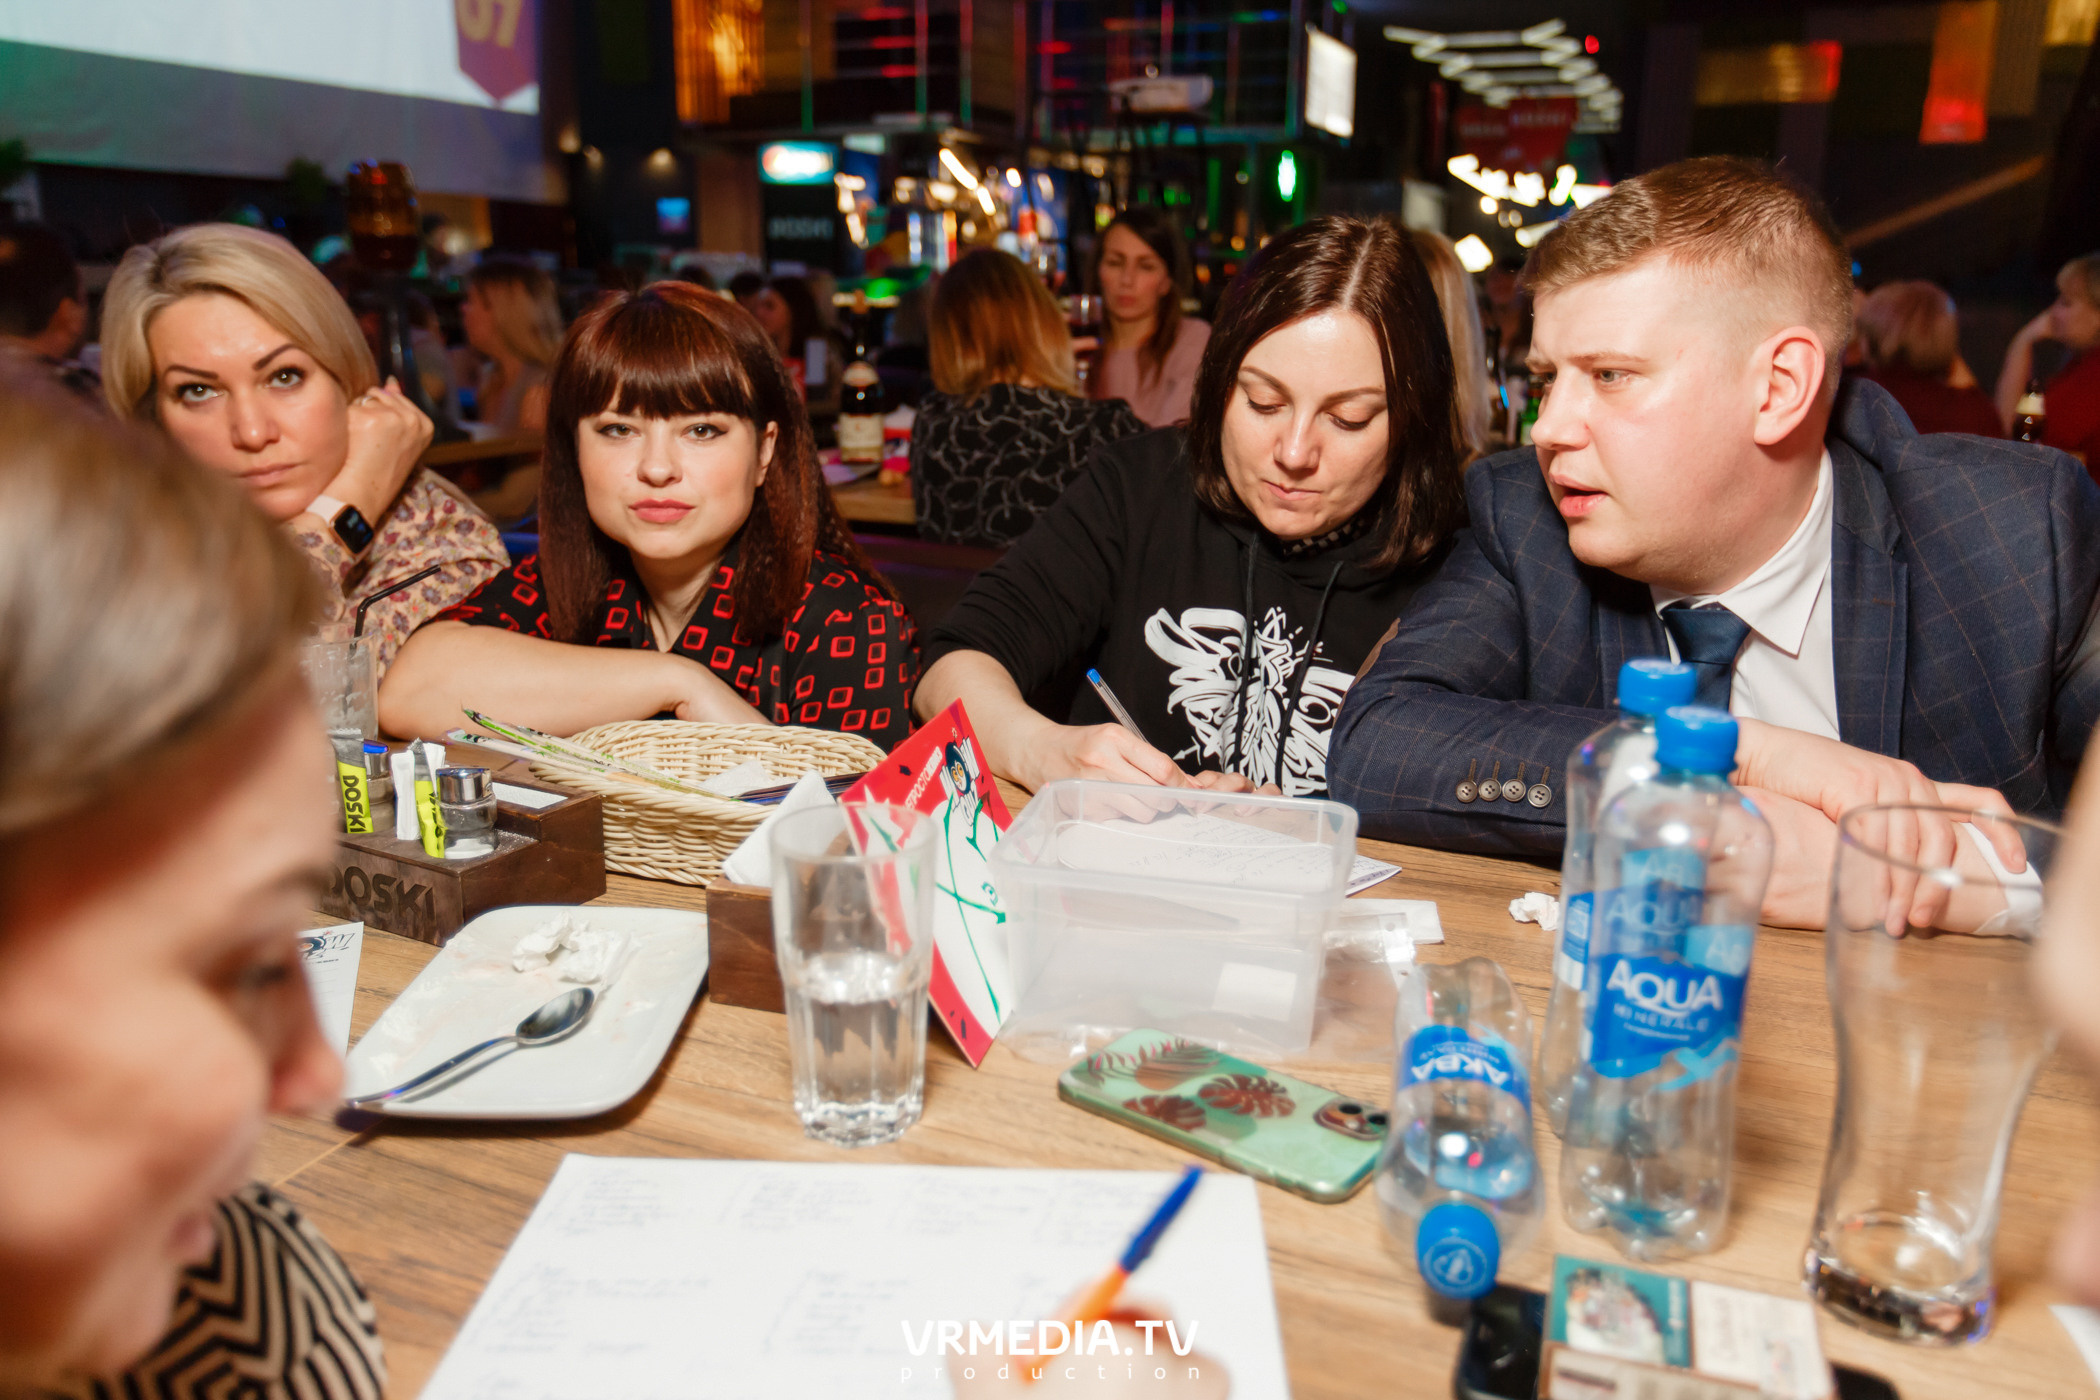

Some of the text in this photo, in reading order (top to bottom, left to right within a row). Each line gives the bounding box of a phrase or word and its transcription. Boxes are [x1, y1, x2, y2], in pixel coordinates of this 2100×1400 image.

[342, 774, 368, 833] DOSKI
[1606, 958, 1724, 1018] AQUA
[1410, 1051, 1509, 1085] АКВА
